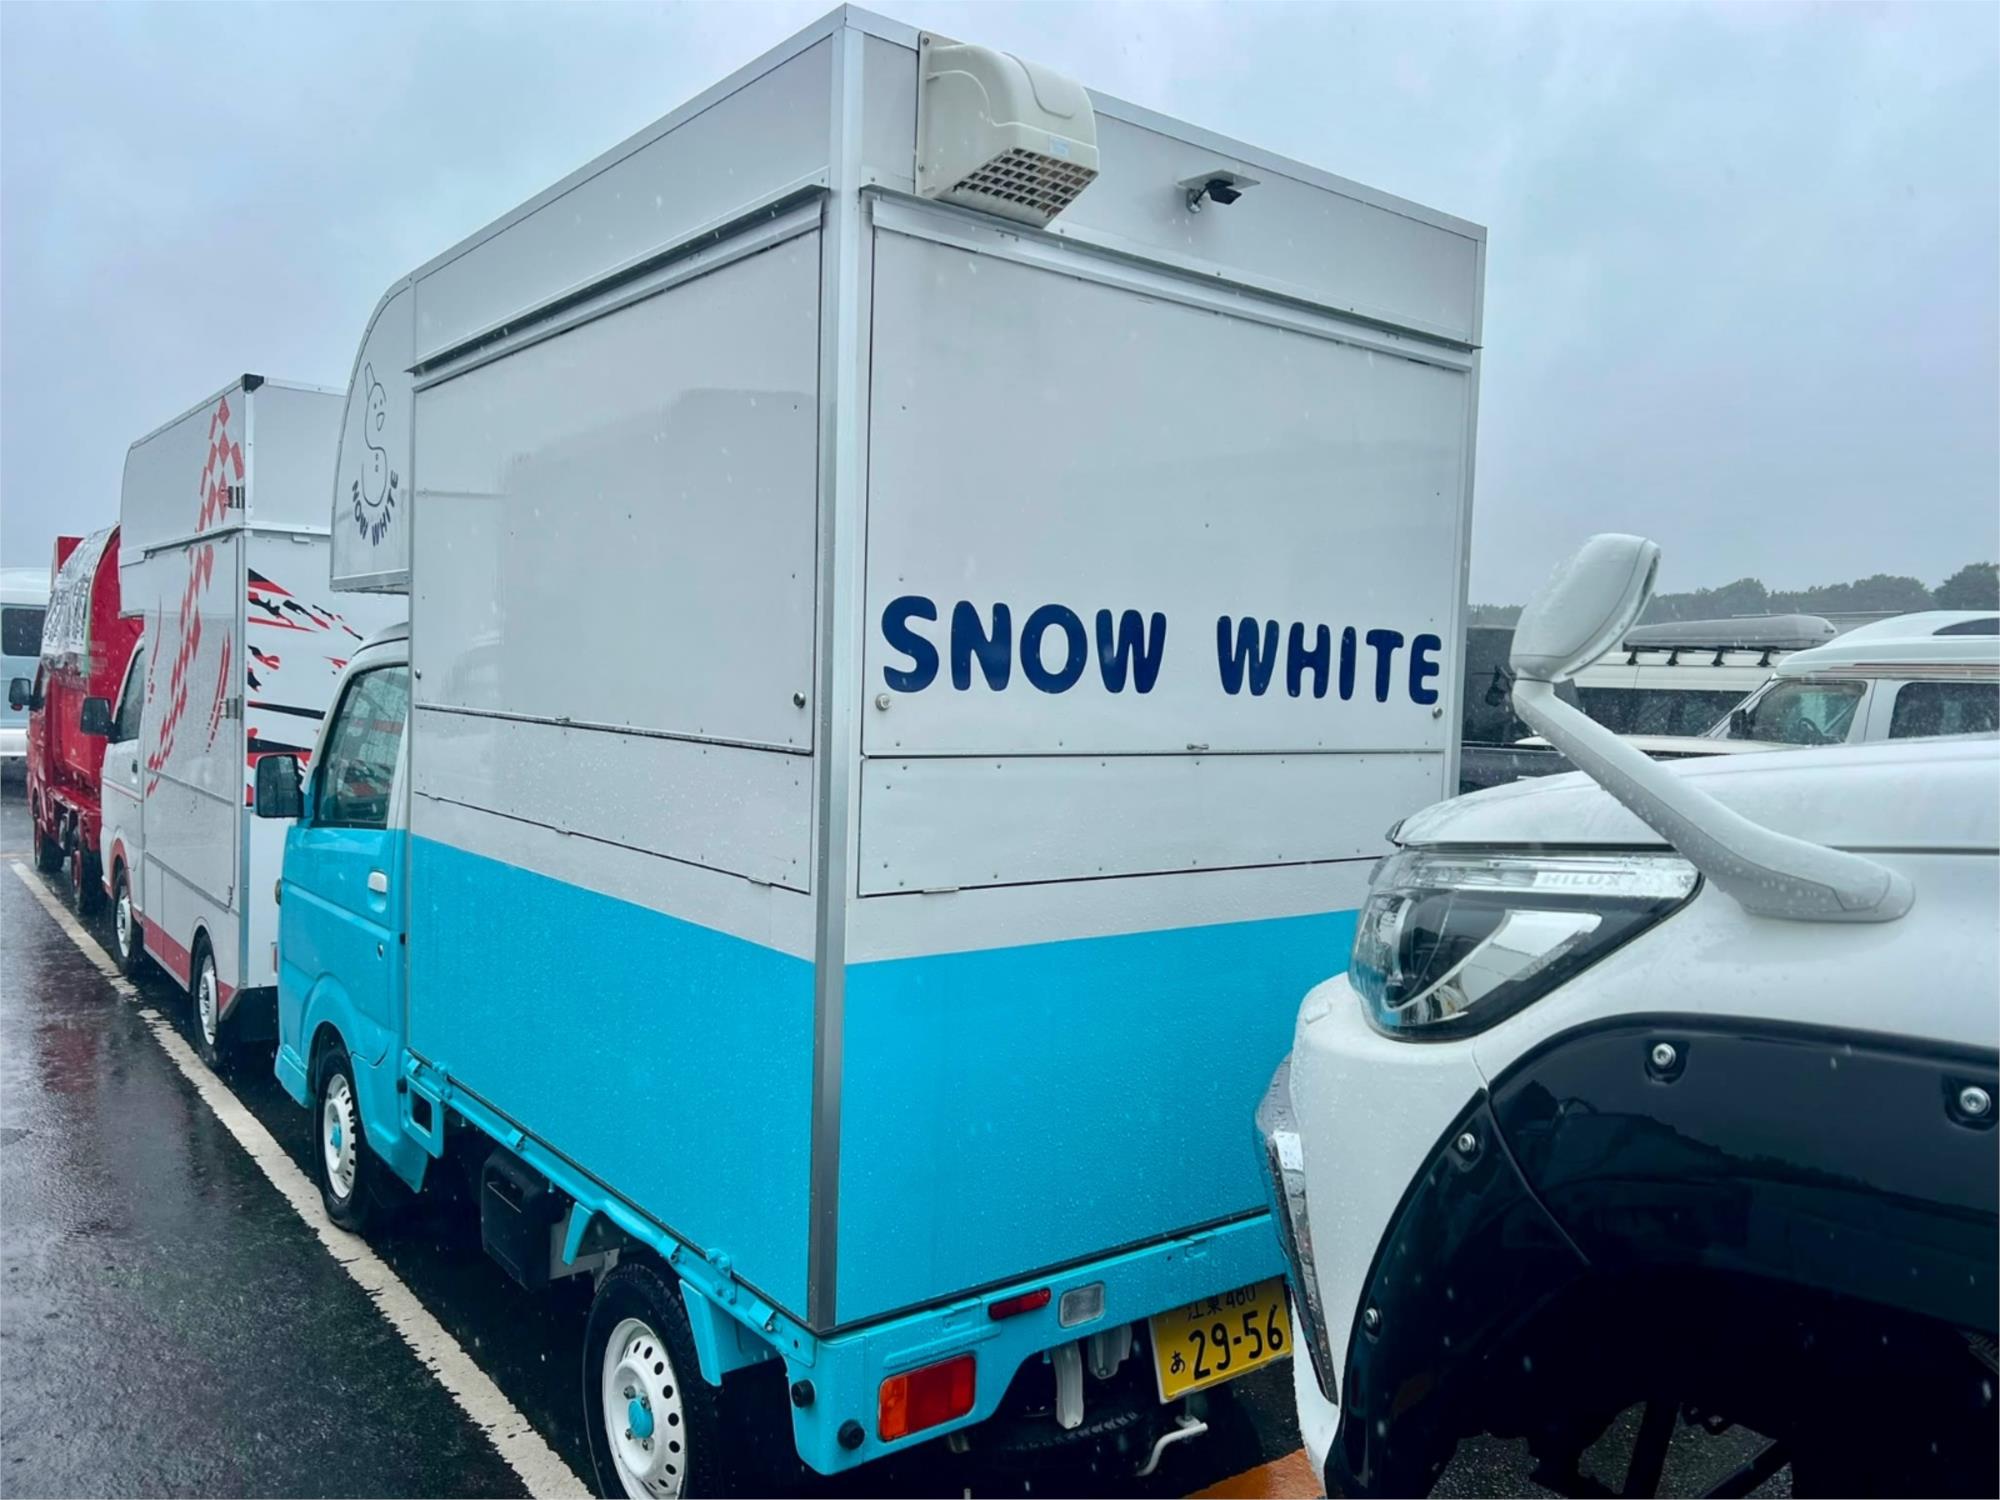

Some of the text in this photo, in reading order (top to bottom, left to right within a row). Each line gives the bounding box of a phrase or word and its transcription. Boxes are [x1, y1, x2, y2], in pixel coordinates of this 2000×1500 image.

[371, 469, 399, 547] WHITE
[881, 595, 1442, 706] SNOW WHITE
[1540, 873, 1620, 887] HILUX
[1170, 1303, 1283, 1381] あ 29-56
